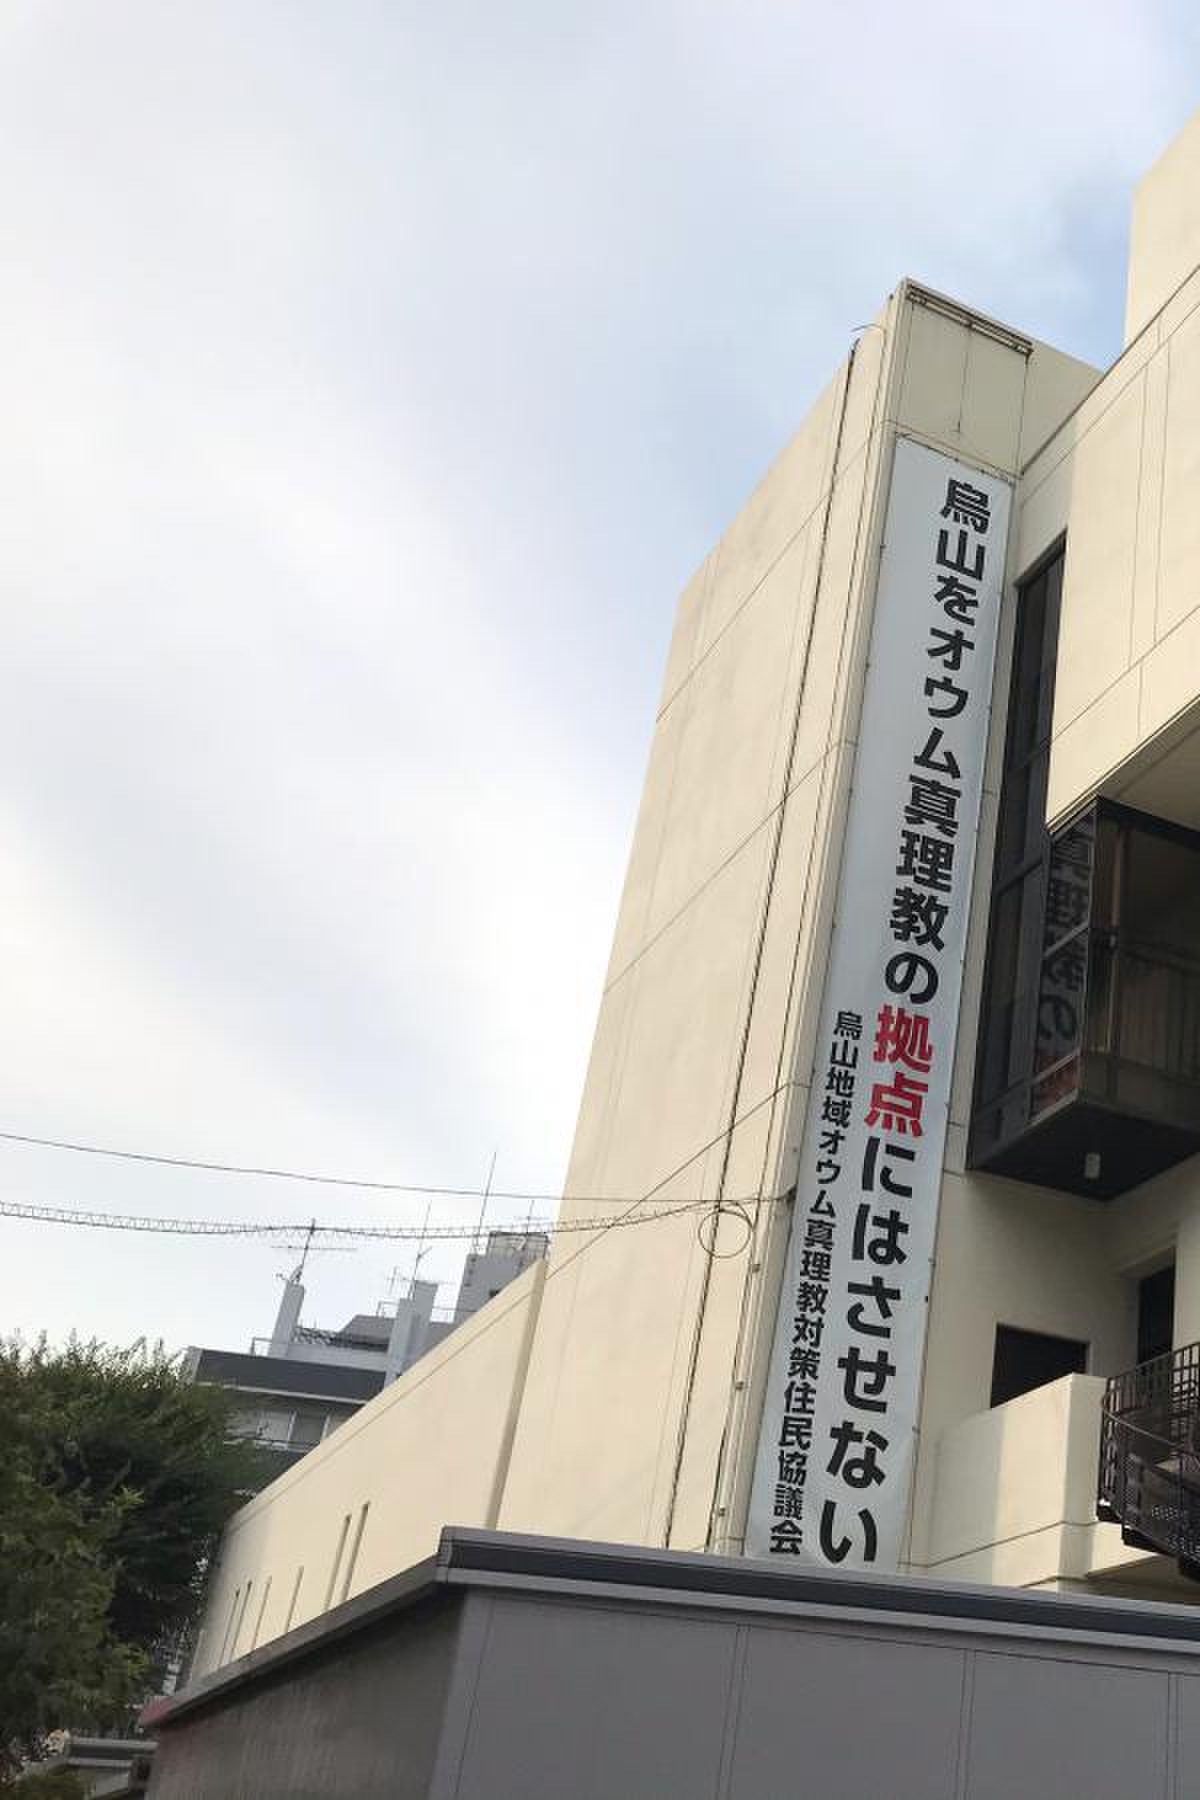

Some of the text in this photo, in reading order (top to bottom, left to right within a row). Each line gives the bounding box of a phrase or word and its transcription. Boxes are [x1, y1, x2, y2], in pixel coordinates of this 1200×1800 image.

[769, 1011, 863, 1555] 烏山地域オウム真理教対策住民協議会
[819, 478, 992, 1564] 烏山をオウム真理教の拠点にはさせない
